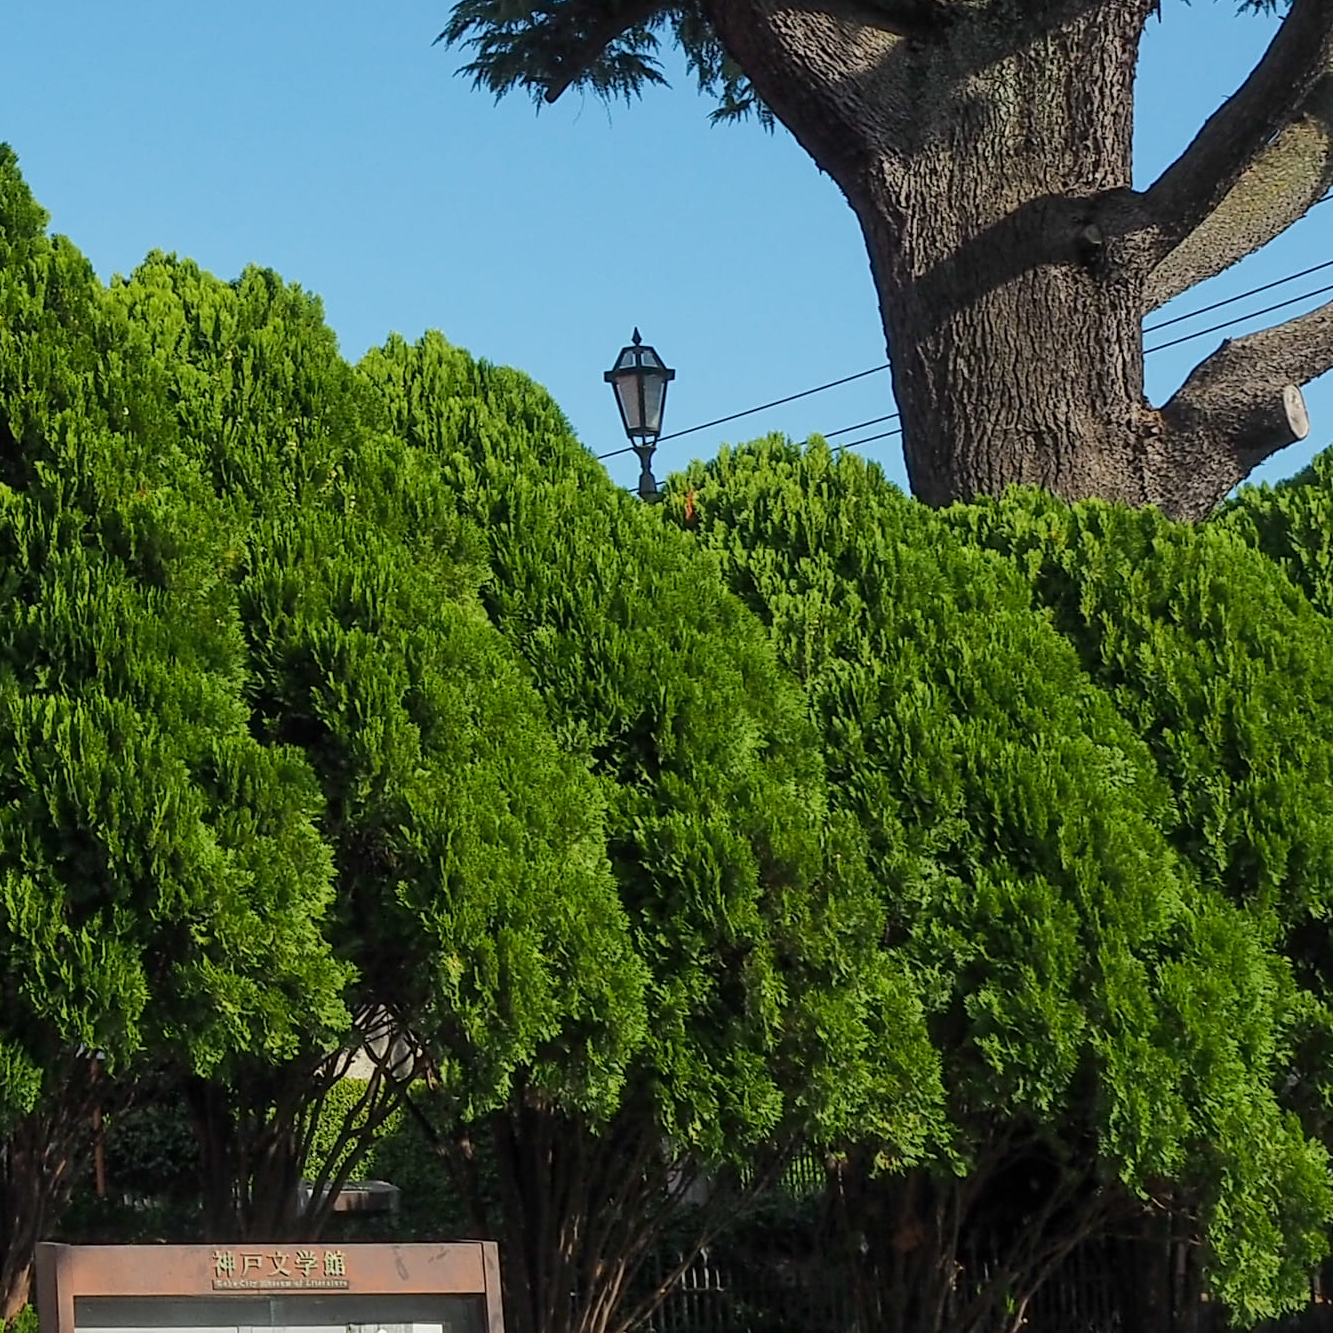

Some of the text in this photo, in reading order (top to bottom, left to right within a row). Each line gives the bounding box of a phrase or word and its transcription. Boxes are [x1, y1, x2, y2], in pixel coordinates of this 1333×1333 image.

[213, 1249, 346, 1278] 神戸文学館
[240, 1279, 257, 1289] City
